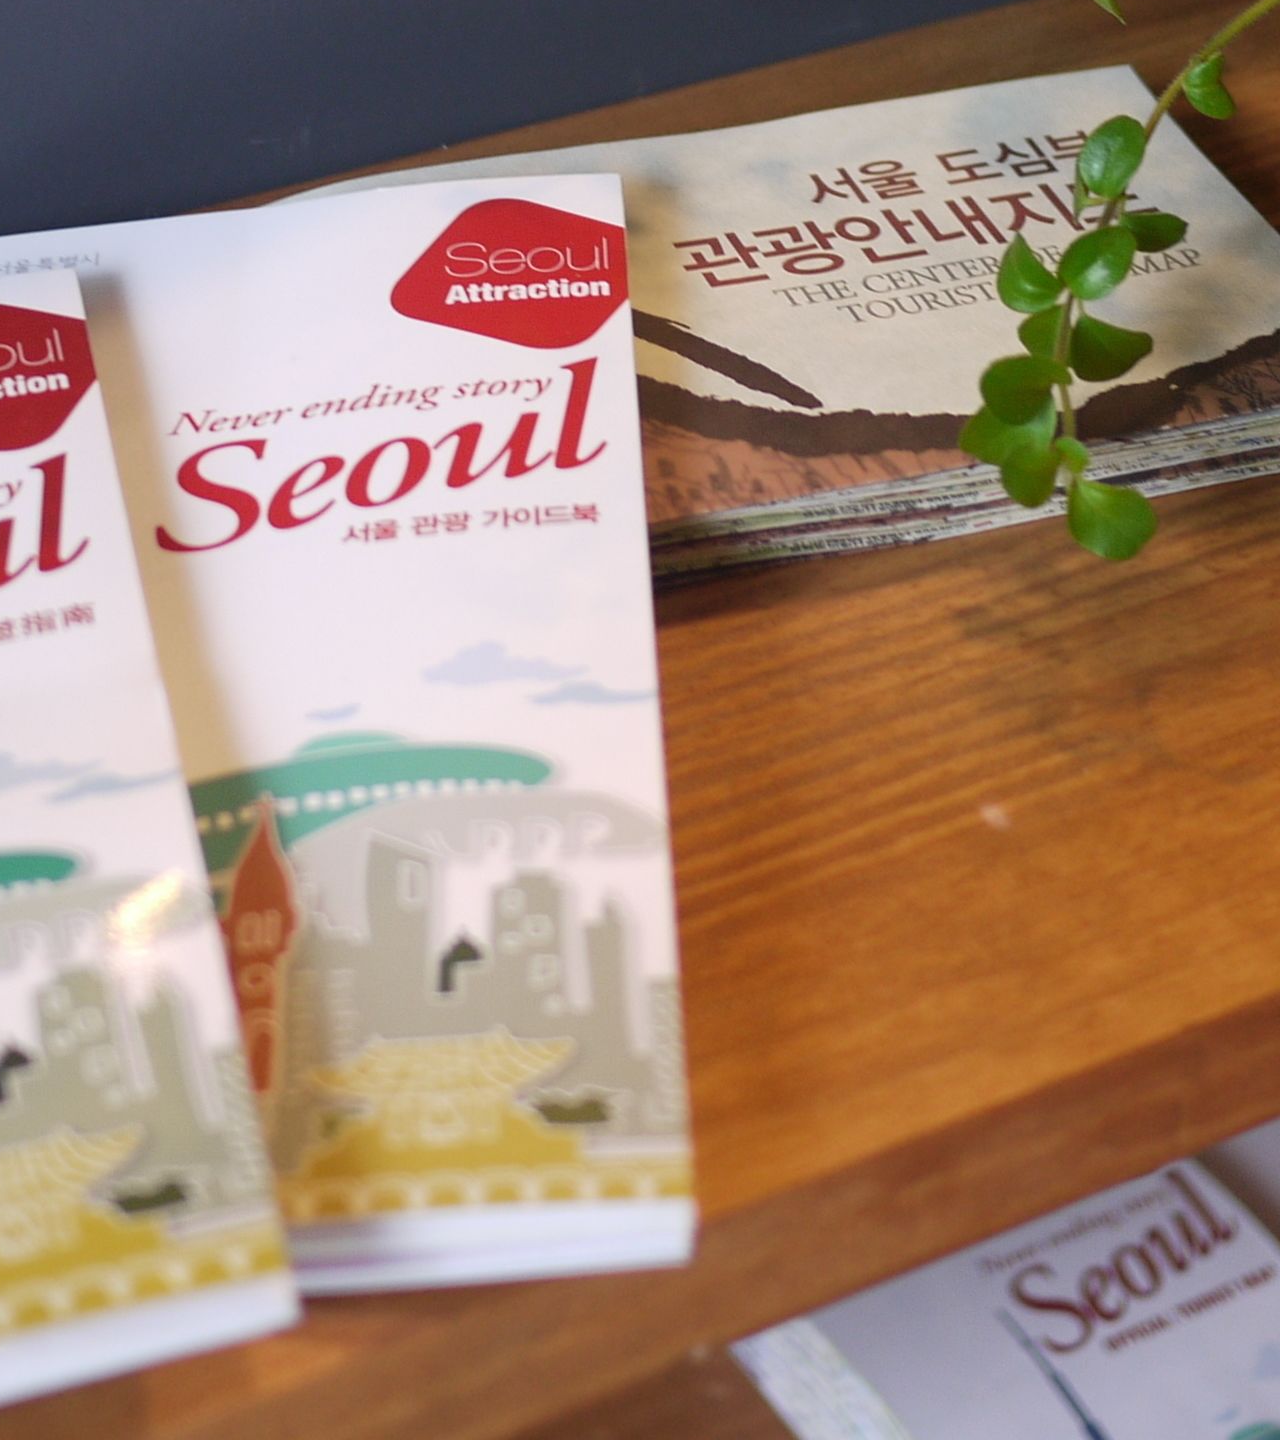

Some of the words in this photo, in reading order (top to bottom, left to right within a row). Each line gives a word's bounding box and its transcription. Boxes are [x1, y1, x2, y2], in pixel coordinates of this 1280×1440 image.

[810, 158, 925, 207] 서울
[443, 236, 609, 278] Seoul
[673, 181, 1160, 287] 관광안내지
[445, 278, 610, 305] Attraction
[773, 279, 857, 307] THE
[862, 256, 1001, 294] CENTER
[1128, 247, 1202, 276] MAP
[837, 282, 998, 323] TOURIST
[170, 408, 293, 437] Never
[301, 380, 444, 421] ending
[452, 374, 553, 402] story
[155, 357, 608, 552] Seoul
[342, 523, 400, 543] 서울
[412, 512, 469, 537] 관광
[483, 503, 601, 530] 가이드북
[1009, 1169, 1239, 1353] Seoul
